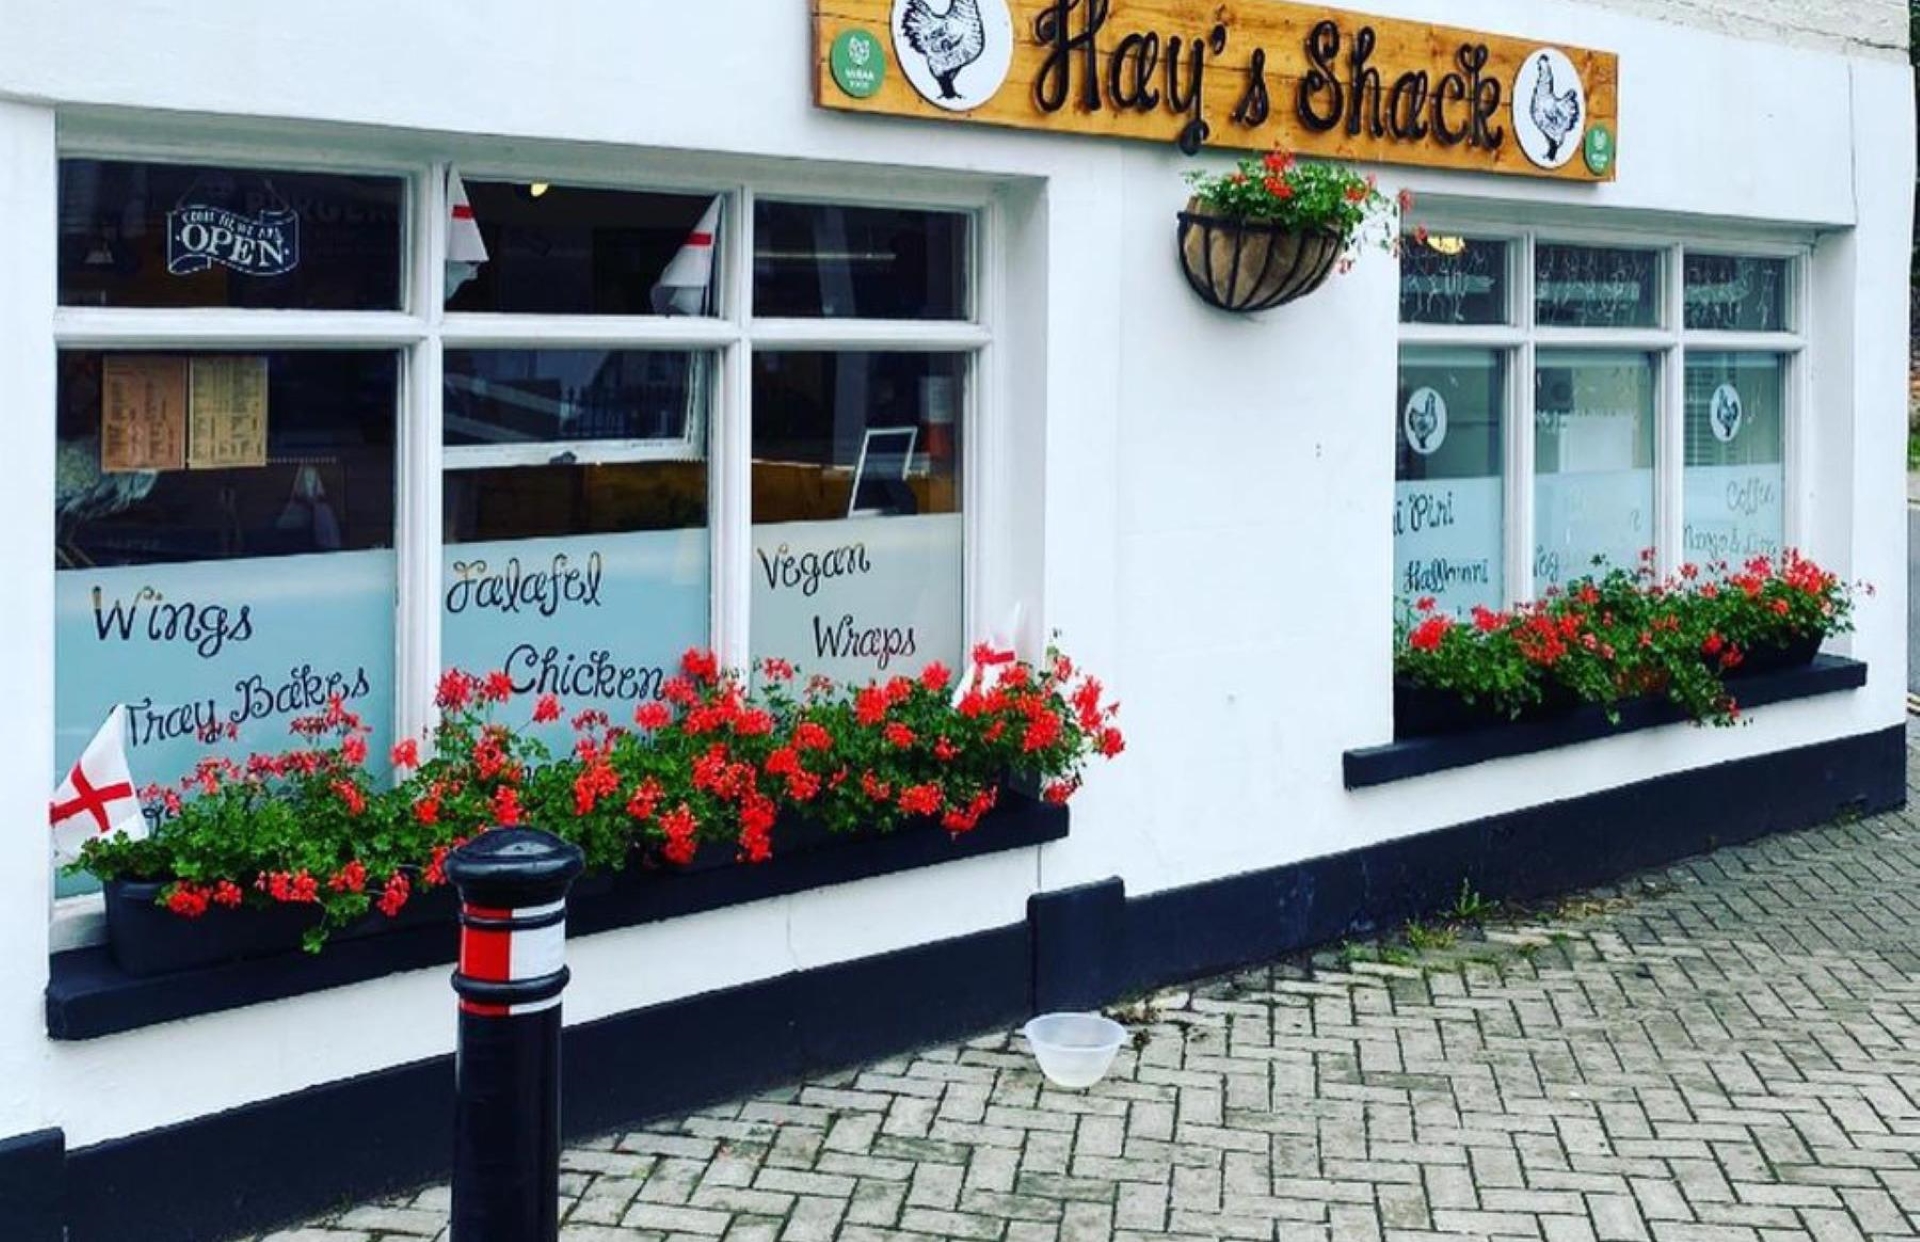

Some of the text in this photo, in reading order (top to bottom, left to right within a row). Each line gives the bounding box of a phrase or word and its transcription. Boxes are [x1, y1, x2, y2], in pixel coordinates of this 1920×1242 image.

[1035, 0, 1504, 156] Hay's Shack
[181, 223, 284, 267] OPEN
[1408, 490, 1455, 532] Piri
[446, 550, 602, 617] Falafel
[757, 542, 871, 597] Vegan
[92, 585, 253, 659] Wings
[813, 613, 916, 671] Wraps
[504, 644, 669, 701] Chicken
[125, 664, 370, 747] Tray Bakes
